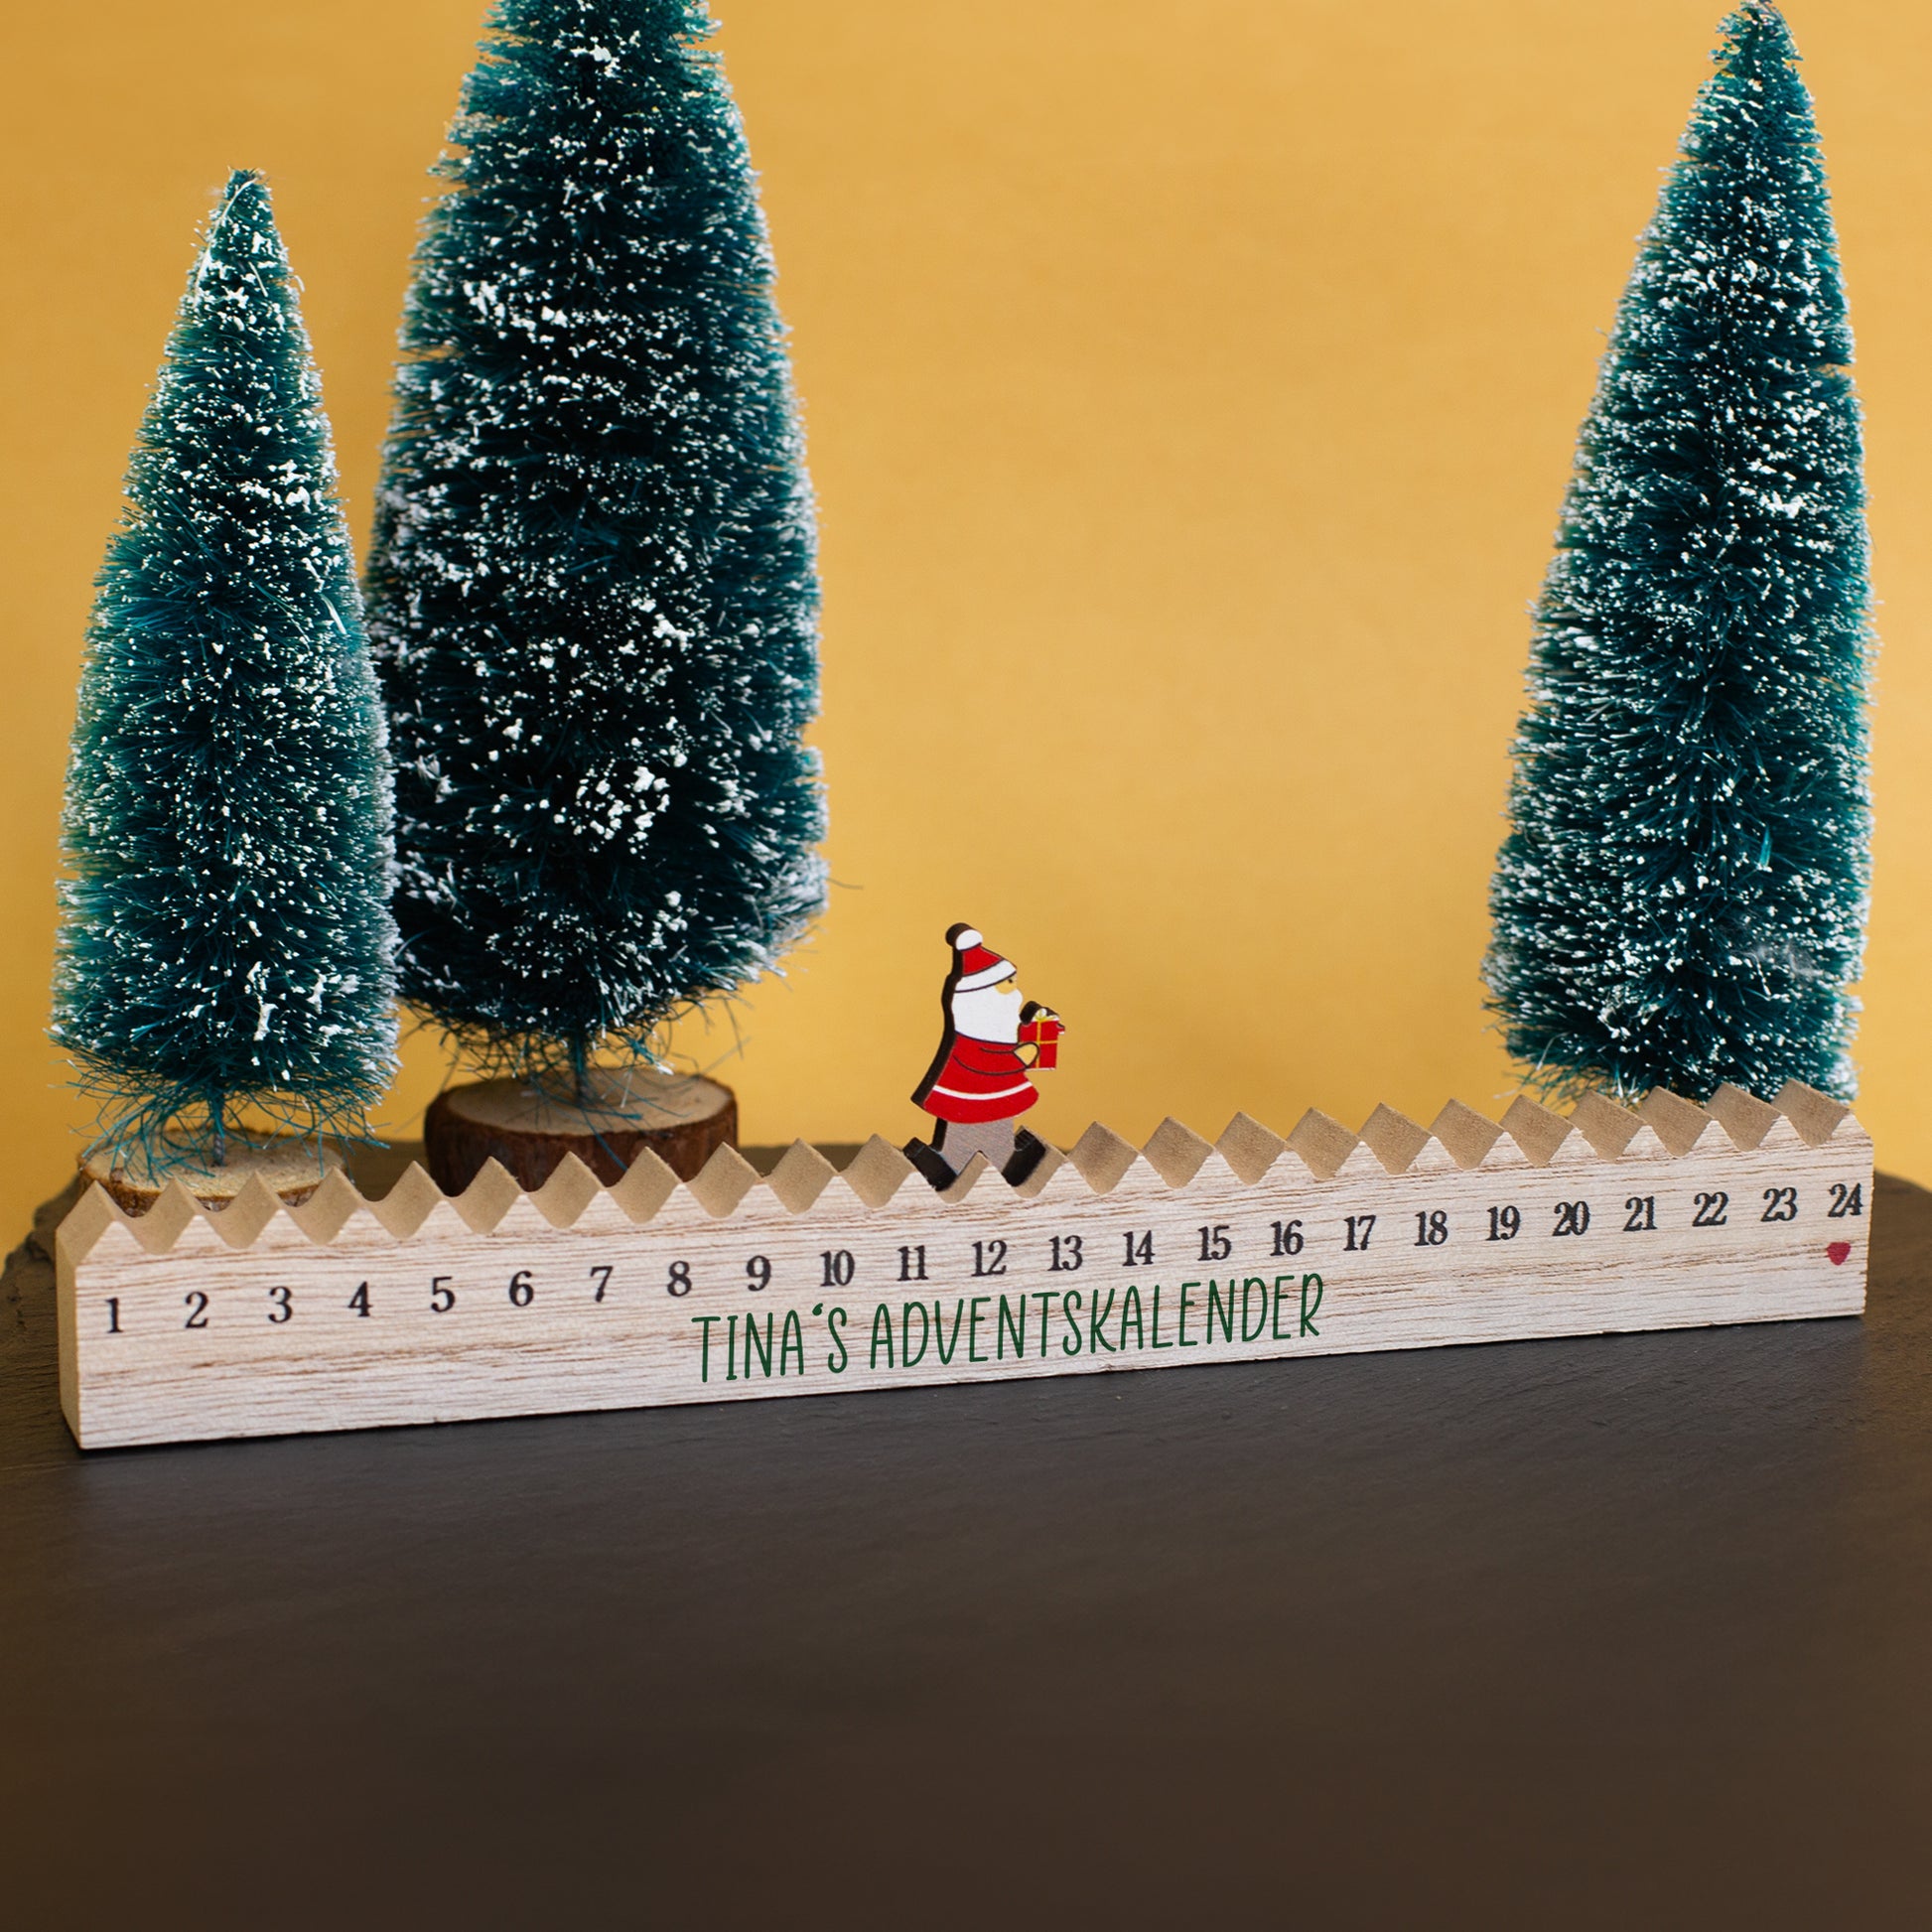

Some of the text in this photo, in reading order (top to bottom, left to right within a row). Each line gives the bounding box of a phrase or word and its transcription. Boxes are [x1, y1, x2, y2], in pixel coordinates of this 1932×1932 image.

[106, 1183, 1863, 1333] 1 2 3 4 5 6 7 8 9 10 11 12 13 14 15 16 17 18 19 20 21 22 23 24
[871, 1274, 1322, 1369] ADVENTSKALENDER
